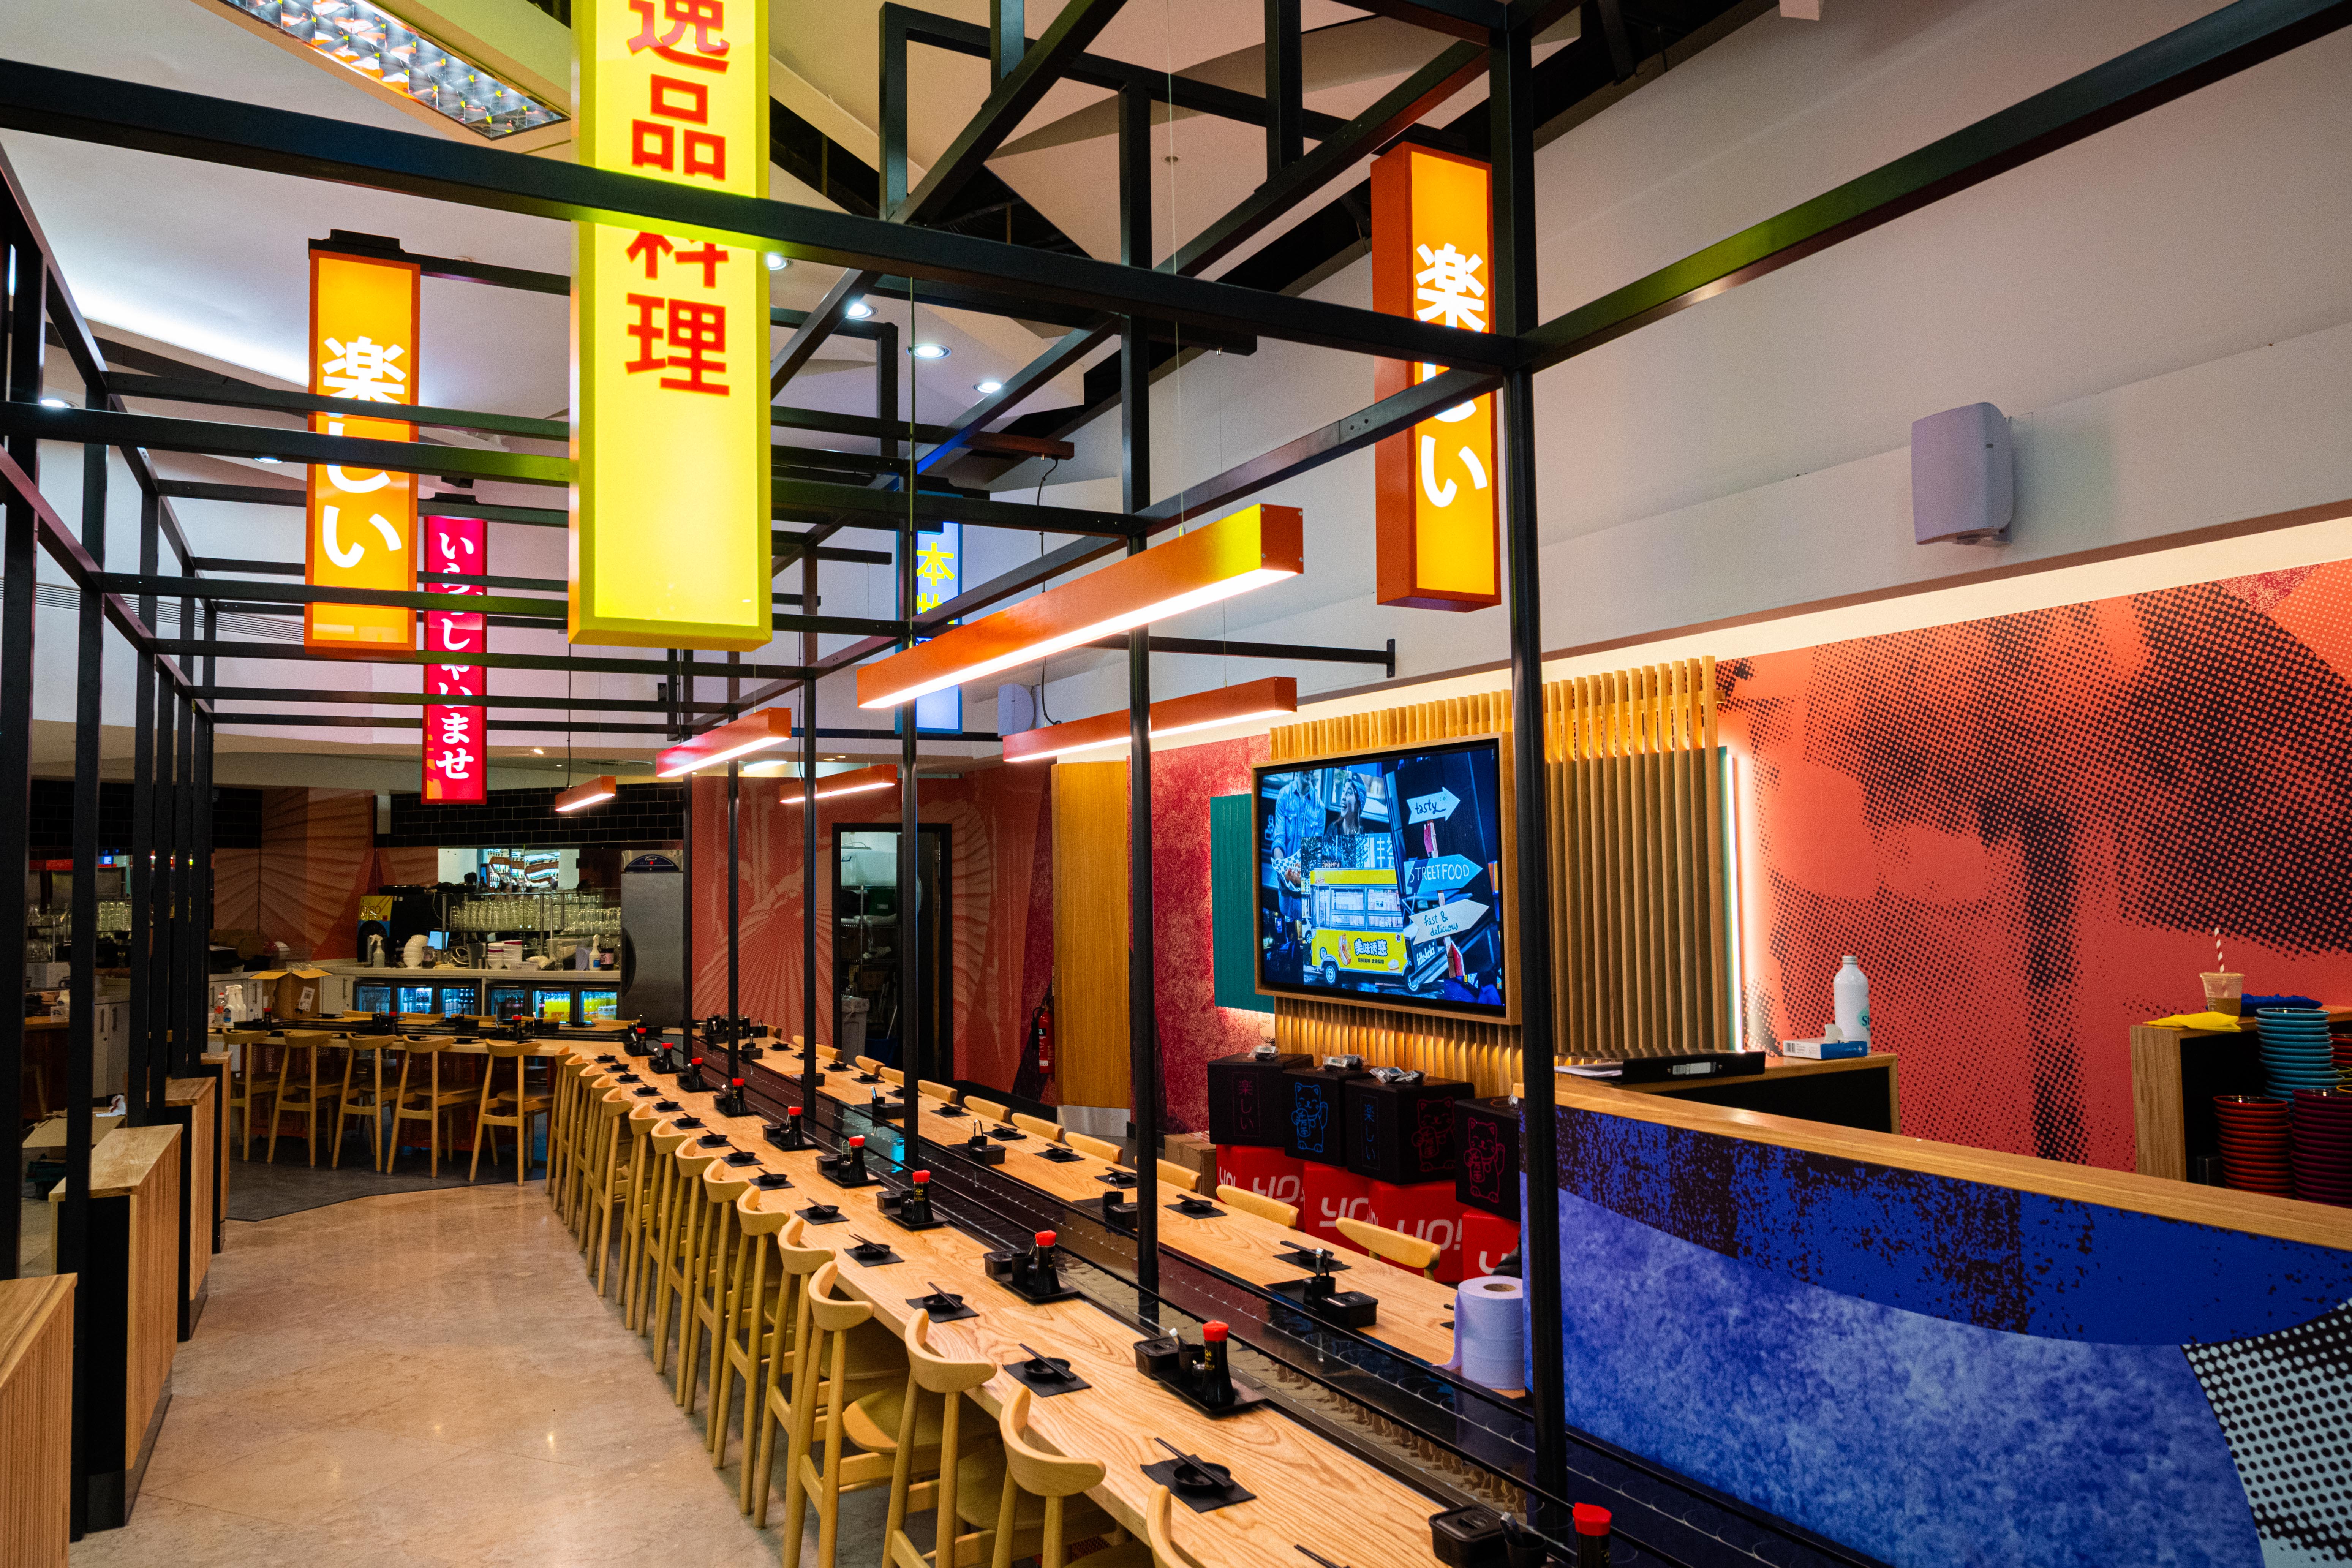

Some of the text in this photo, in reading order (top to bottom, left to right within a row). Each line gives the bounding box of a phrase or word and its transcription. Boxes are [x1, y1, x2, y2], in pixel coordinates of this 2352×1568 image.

[1415, 799, 1446, 815] tasty
[1424, 911, 1448, 927] fast &
[1430, 922, 1458, 936] delicious
[1238, 1080, 1254, 1130] 楽しい
